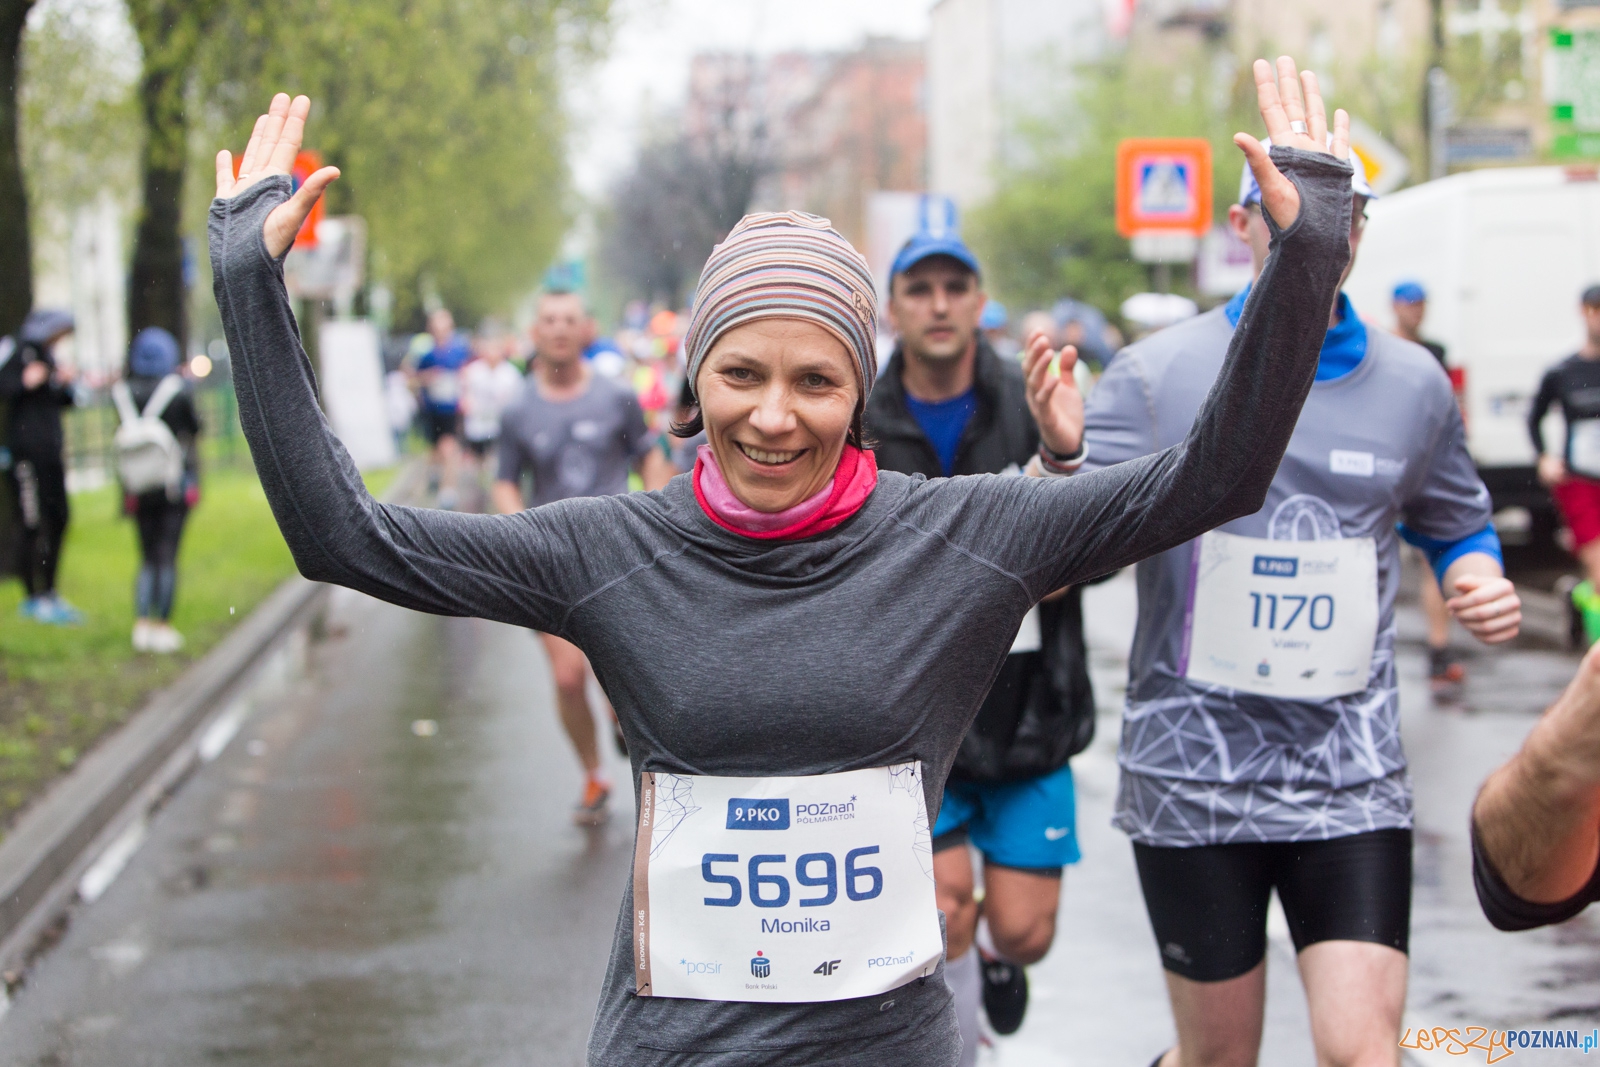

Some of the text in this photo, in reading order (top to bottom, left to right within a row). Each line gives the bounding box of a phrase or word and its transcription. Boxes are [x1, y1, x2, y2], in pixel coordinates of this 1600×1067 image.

[855, 293, 871, 322] Buff
[1249, 592, 1334, 631] 1170
[643, 789, 652, 827] 17.04.2016
[796, 813, 855, 824] PÓŁMARATON
[702, 845, 883, 908] 5696
[761, 918, 831, 933] Monika
[813, 959, 842, 976] 4F
